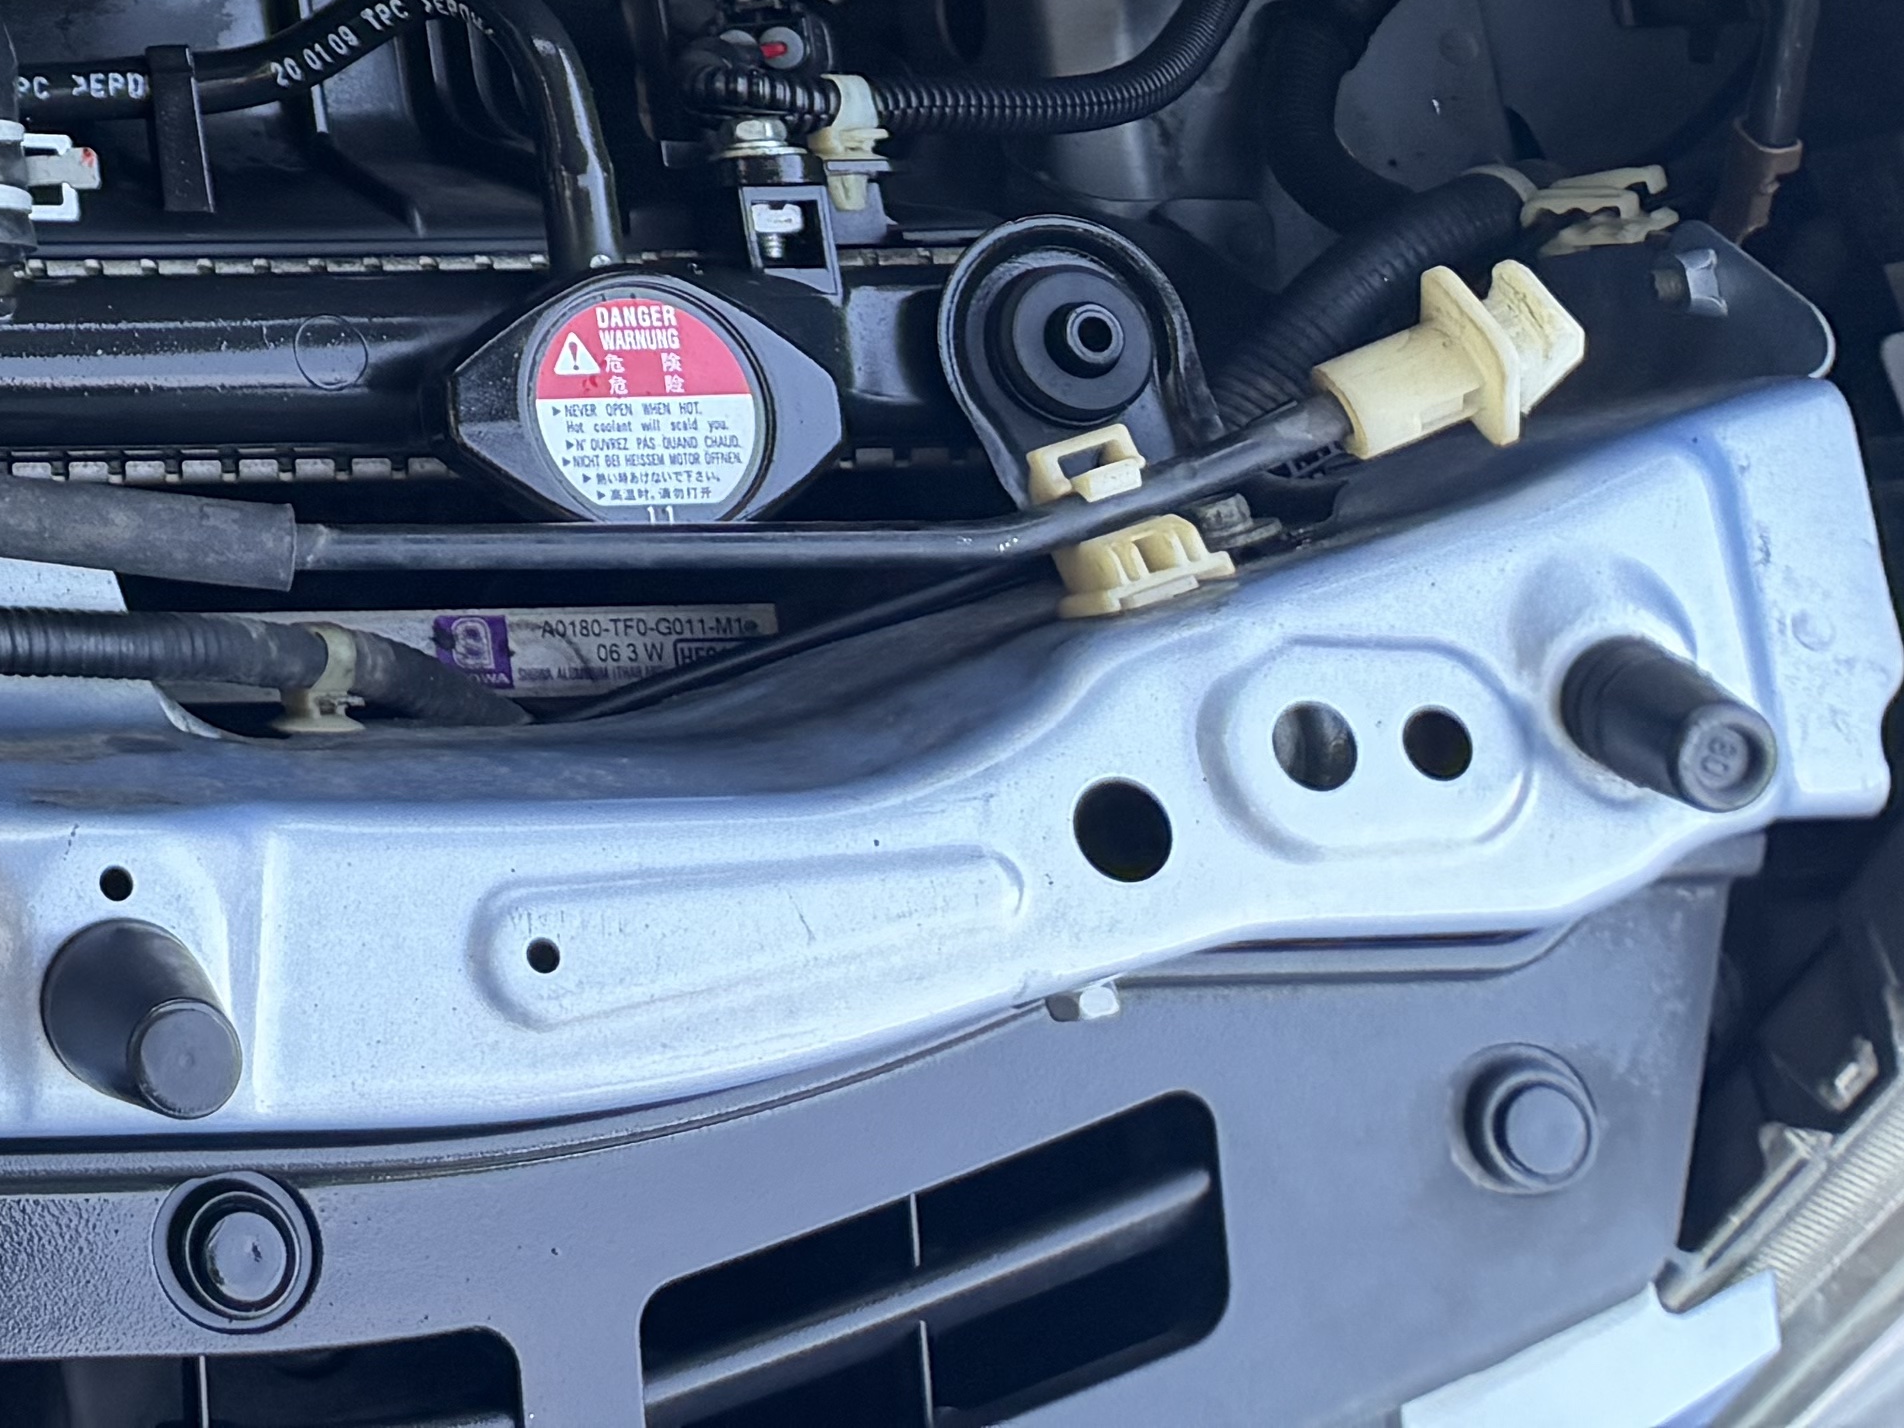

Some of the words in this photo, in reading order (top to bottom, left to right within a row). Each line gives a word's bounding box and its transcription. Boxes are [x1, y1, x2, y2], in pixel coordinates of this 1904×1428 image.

[595, 305, 678, 328] DANGER
[598, 328, 680, 351] WARNUNG
[564, 403, 597, 418] NEVER
[605, 402, 633, 417] OPEN
[643, 401, 671, 416] WHEN
[566, 420, 585, 433] Hot
[593, 419, 632, 433] coolant
[641, 419, 661, 432] will
[670, 417, 699, 431] scald
[591, 437, 629, 451] OUVREZ
[636, 435, 657, 450] PAS
[661, 435, 699, 450] QUAND
[573, 455, 600, 468] NICHT
[604, 454, 621, 468] BEI
[624, 453, 665, 467] HEISSEM
[668, 452, 701, 466] MOTOR
[598, 643, 621, 663] 06
[626, 643, 639, 662] 3
[646, 642, 664, 661] W
